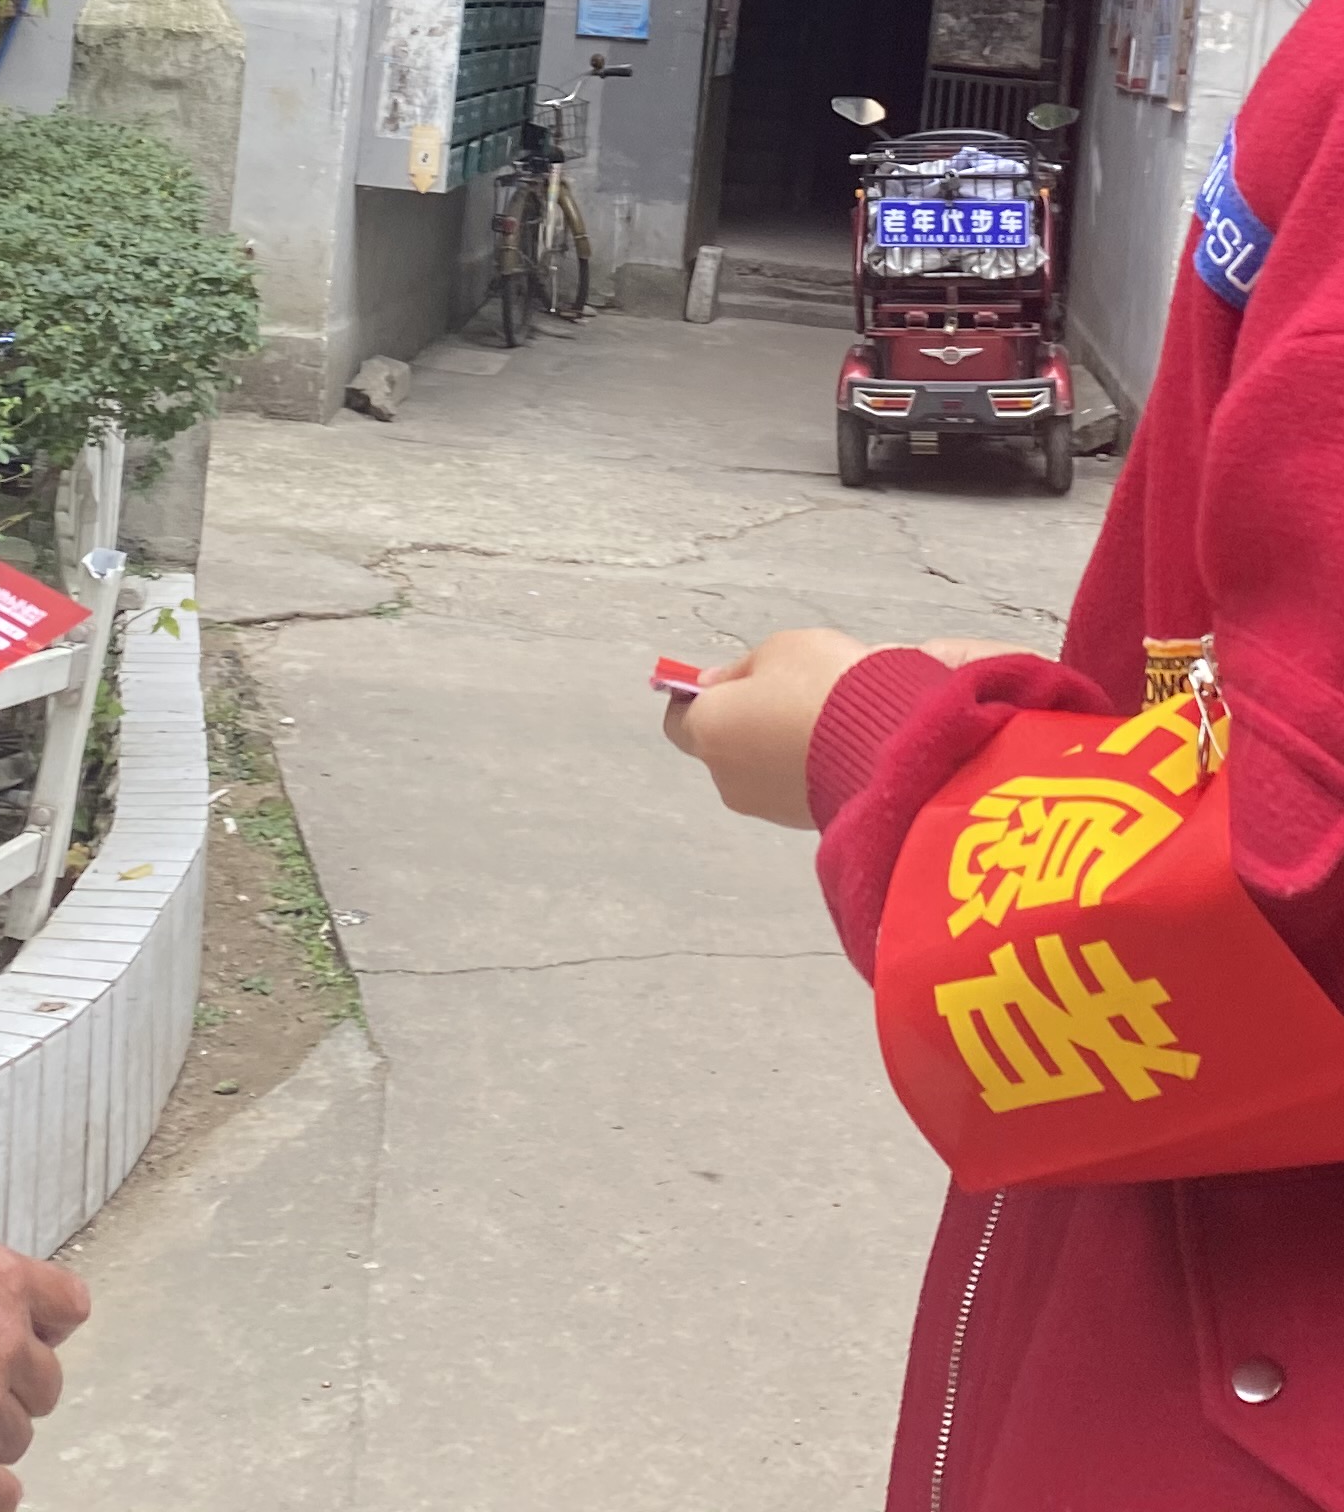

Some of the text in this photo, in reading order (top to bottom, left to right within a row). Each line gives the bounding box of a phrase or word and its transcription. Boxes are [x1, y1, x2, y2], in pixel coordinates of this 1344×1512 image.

[883, 208, 1023, 233] 老年代步车
[884, 234, 908, 243] LAO
[949, 234, 971, 243] DAI
[998, 235, 1022, 244] CHE
